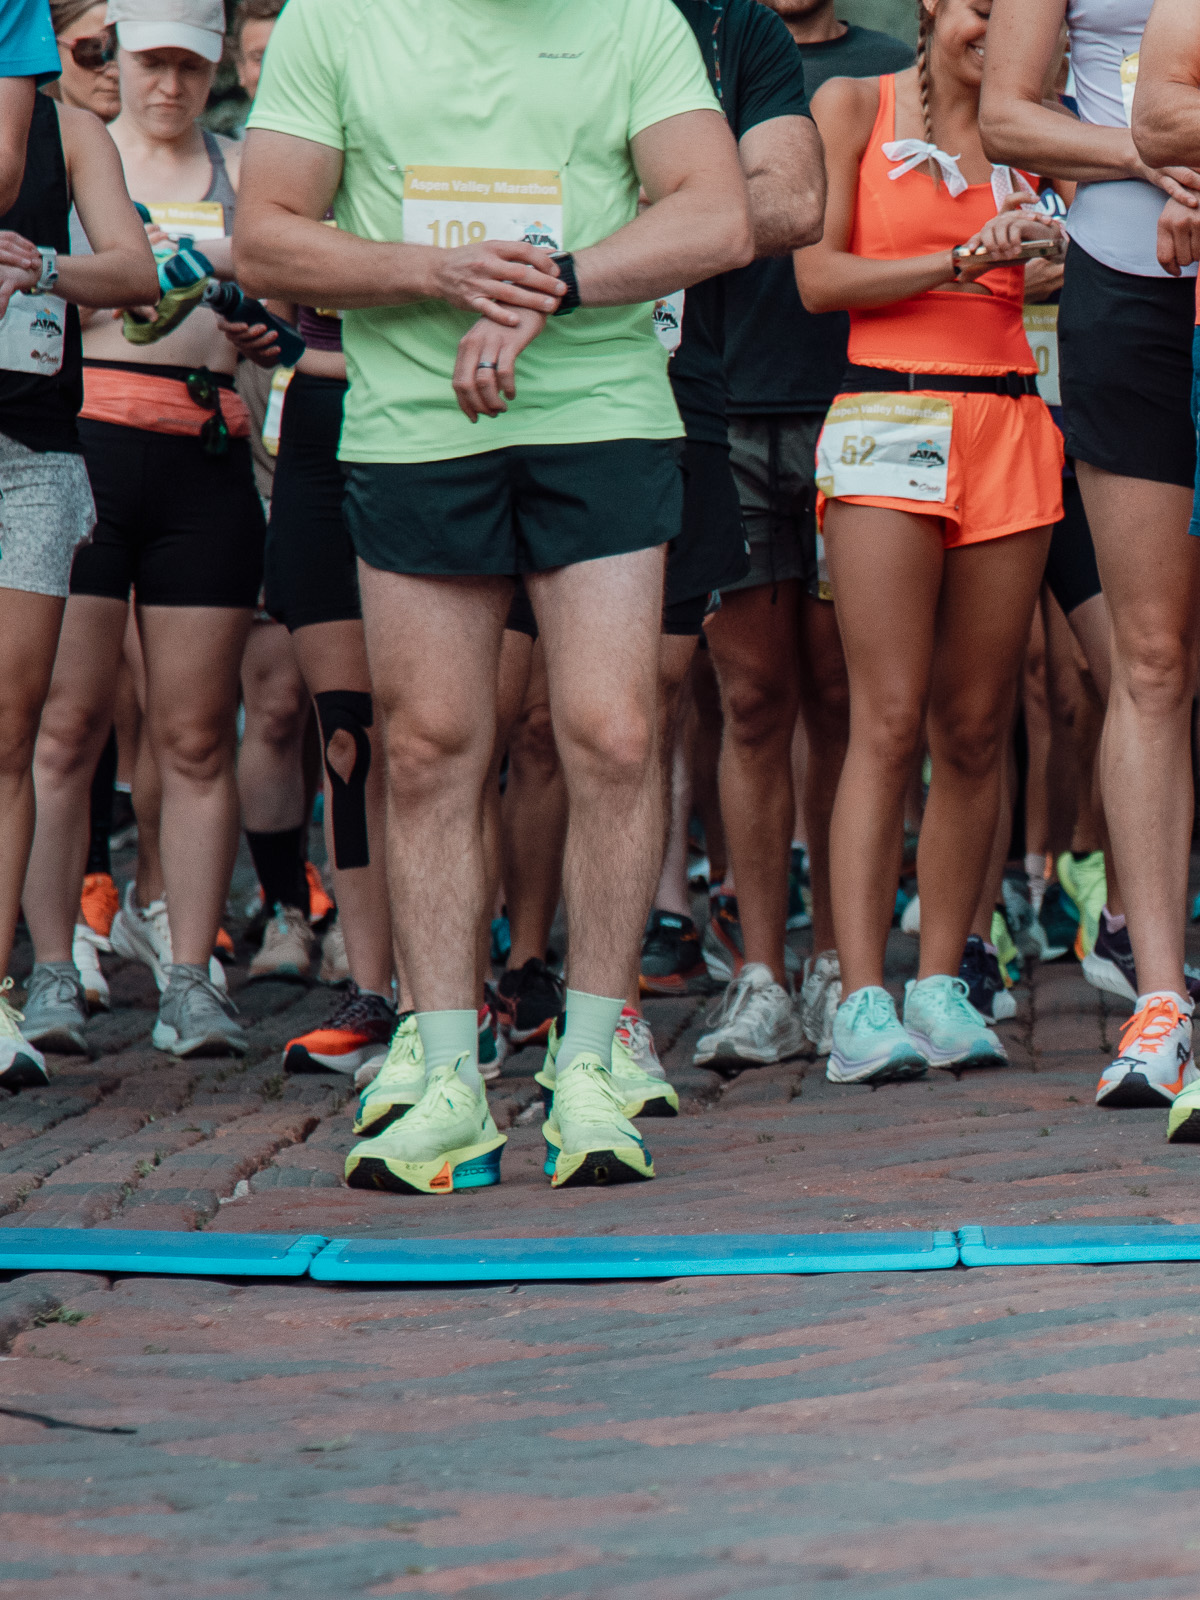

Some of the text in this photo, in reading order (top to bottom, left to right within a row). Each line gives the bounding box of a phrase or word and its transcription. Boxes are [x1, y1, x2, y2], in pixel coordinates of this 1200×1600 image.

[410, 179, 558, 196] Aspen Valley Marathon
[861, 404, 892, 416] Valley
[894, 405, 949, 420] Marathon
[841, 435, 877, 467] 52
